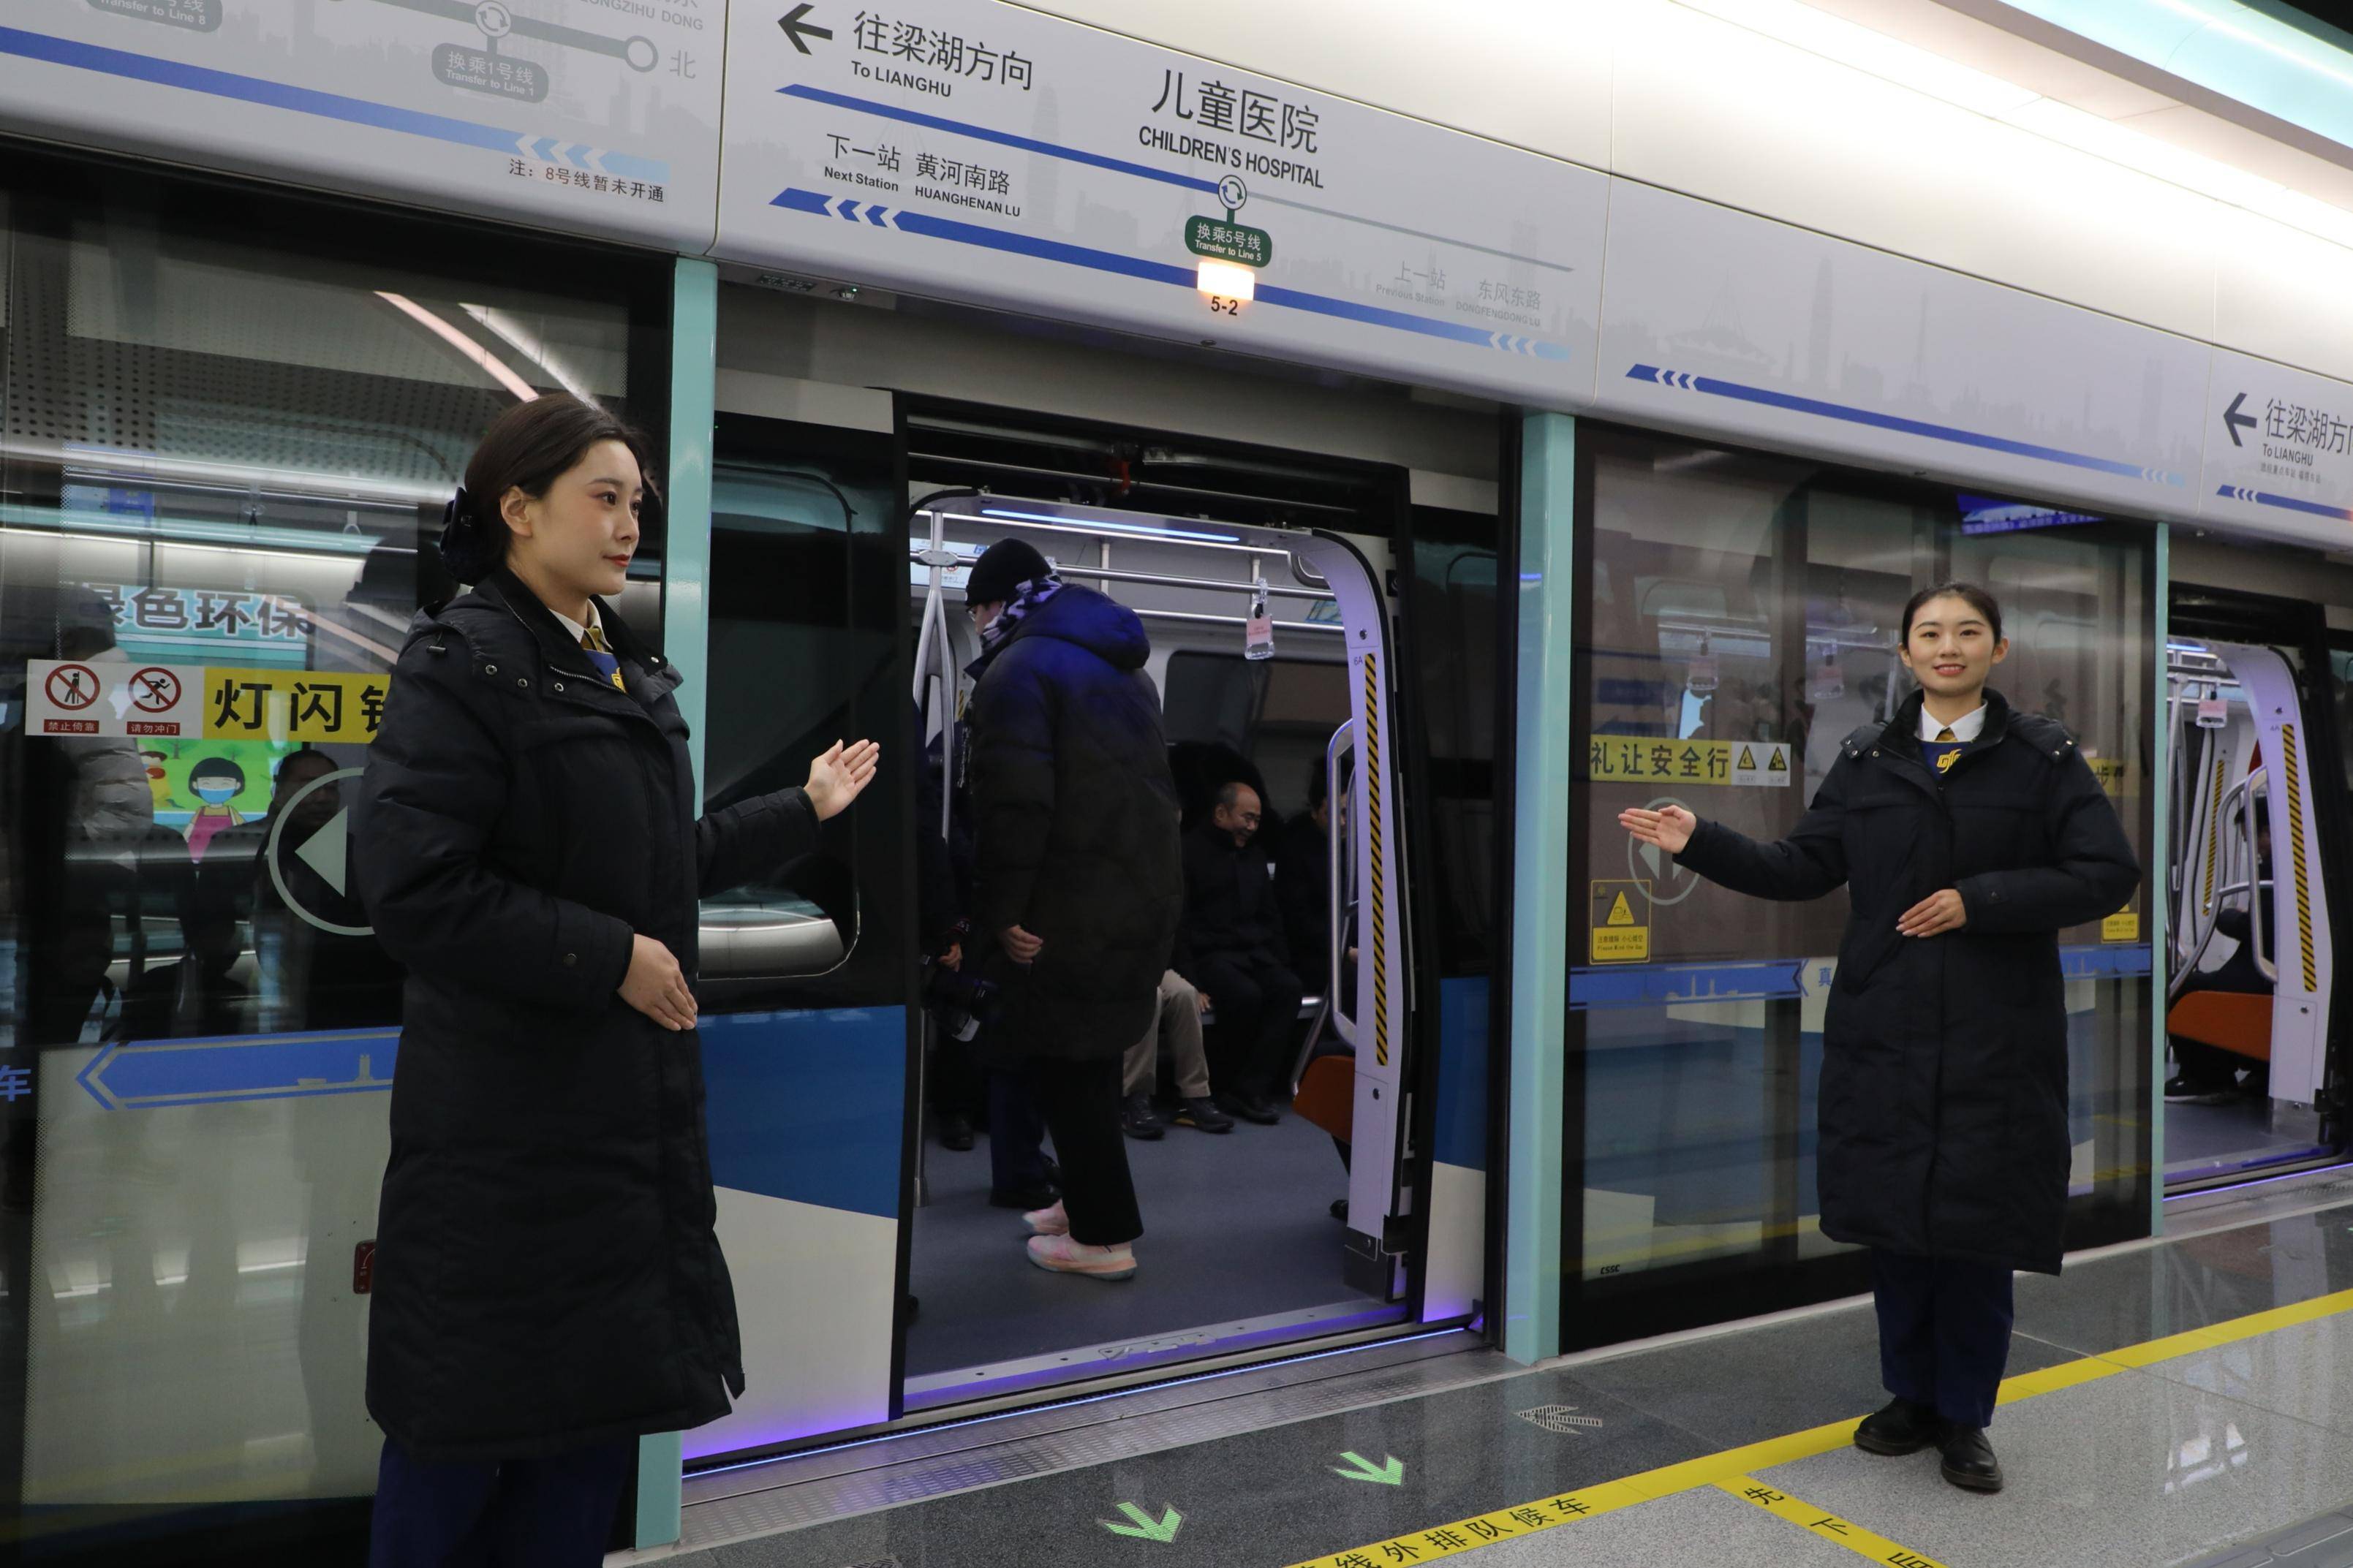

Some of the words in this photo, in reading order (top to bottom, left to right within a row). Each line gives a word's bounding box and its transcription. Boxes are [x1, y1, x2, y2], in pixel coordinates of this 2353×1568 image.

[152, 6, 165, 16] to
[169, 9, 194, 23] Line
[198, 15, 206, 25] 8
[581, 0, 655, 19] NGZIHU
[661, 10, 703, 31] DONG
[669, 50, 697, 80] 北
[853, 10, 1033, 91] 往梁湖方向
[445, 69, 487, 86] Transfer
[491, 79, 501, 89] to
[504, 81, 525, 94] Line
[529, 88, 534, 96] 1
[447, 51, 533, 85] 换乘1号线
[851, 61, 870, 78] To
[875, 67, 952, 98] LIANGHU
[1152, 69, 1319, 154] 儿童医院
[826, 133, 900, 173] 下一站
[915, 152, 1011, 196] 黄河南路
[1245, 152, 1324, 189] HOSPITAL
[824, 166, 853, 183] Next
[856, 173, 899, 192] Station
[915, 186, 1002, 214] HUANGHENAN
[1005, 203, 1021, 217] LU
[1195, 239, 1226, 254] Transfer
[1228, 247, 1236, 256] to
[1238, 249, 1254, 260] Line
[1256, 253, 1261, 262] 5
[1197, 222, 1261, 251] 换乘5号线
[1375, 283, 1413, 302] Previous
[1415, 291, 1446, 308] Station
[1394, 260, 1446, 292] 上一站
[1478, 279, 1541, 311] 东风东路
[1210, 295, 1239, 316] 5-2
[2262, 443, 2273, 457] To
[2274, 445, 2314, 466] LIANGHU
[48, 721, 95, 732] 禁止倚靠
[131, 724, 177, 733] 请勿冲门
[1590, 741, 1729, 779] 礼让安全行
[1601, 1264, 1620, 1275] CSSC
[1301, 1497, 1590, 1568] 线外排队候车
